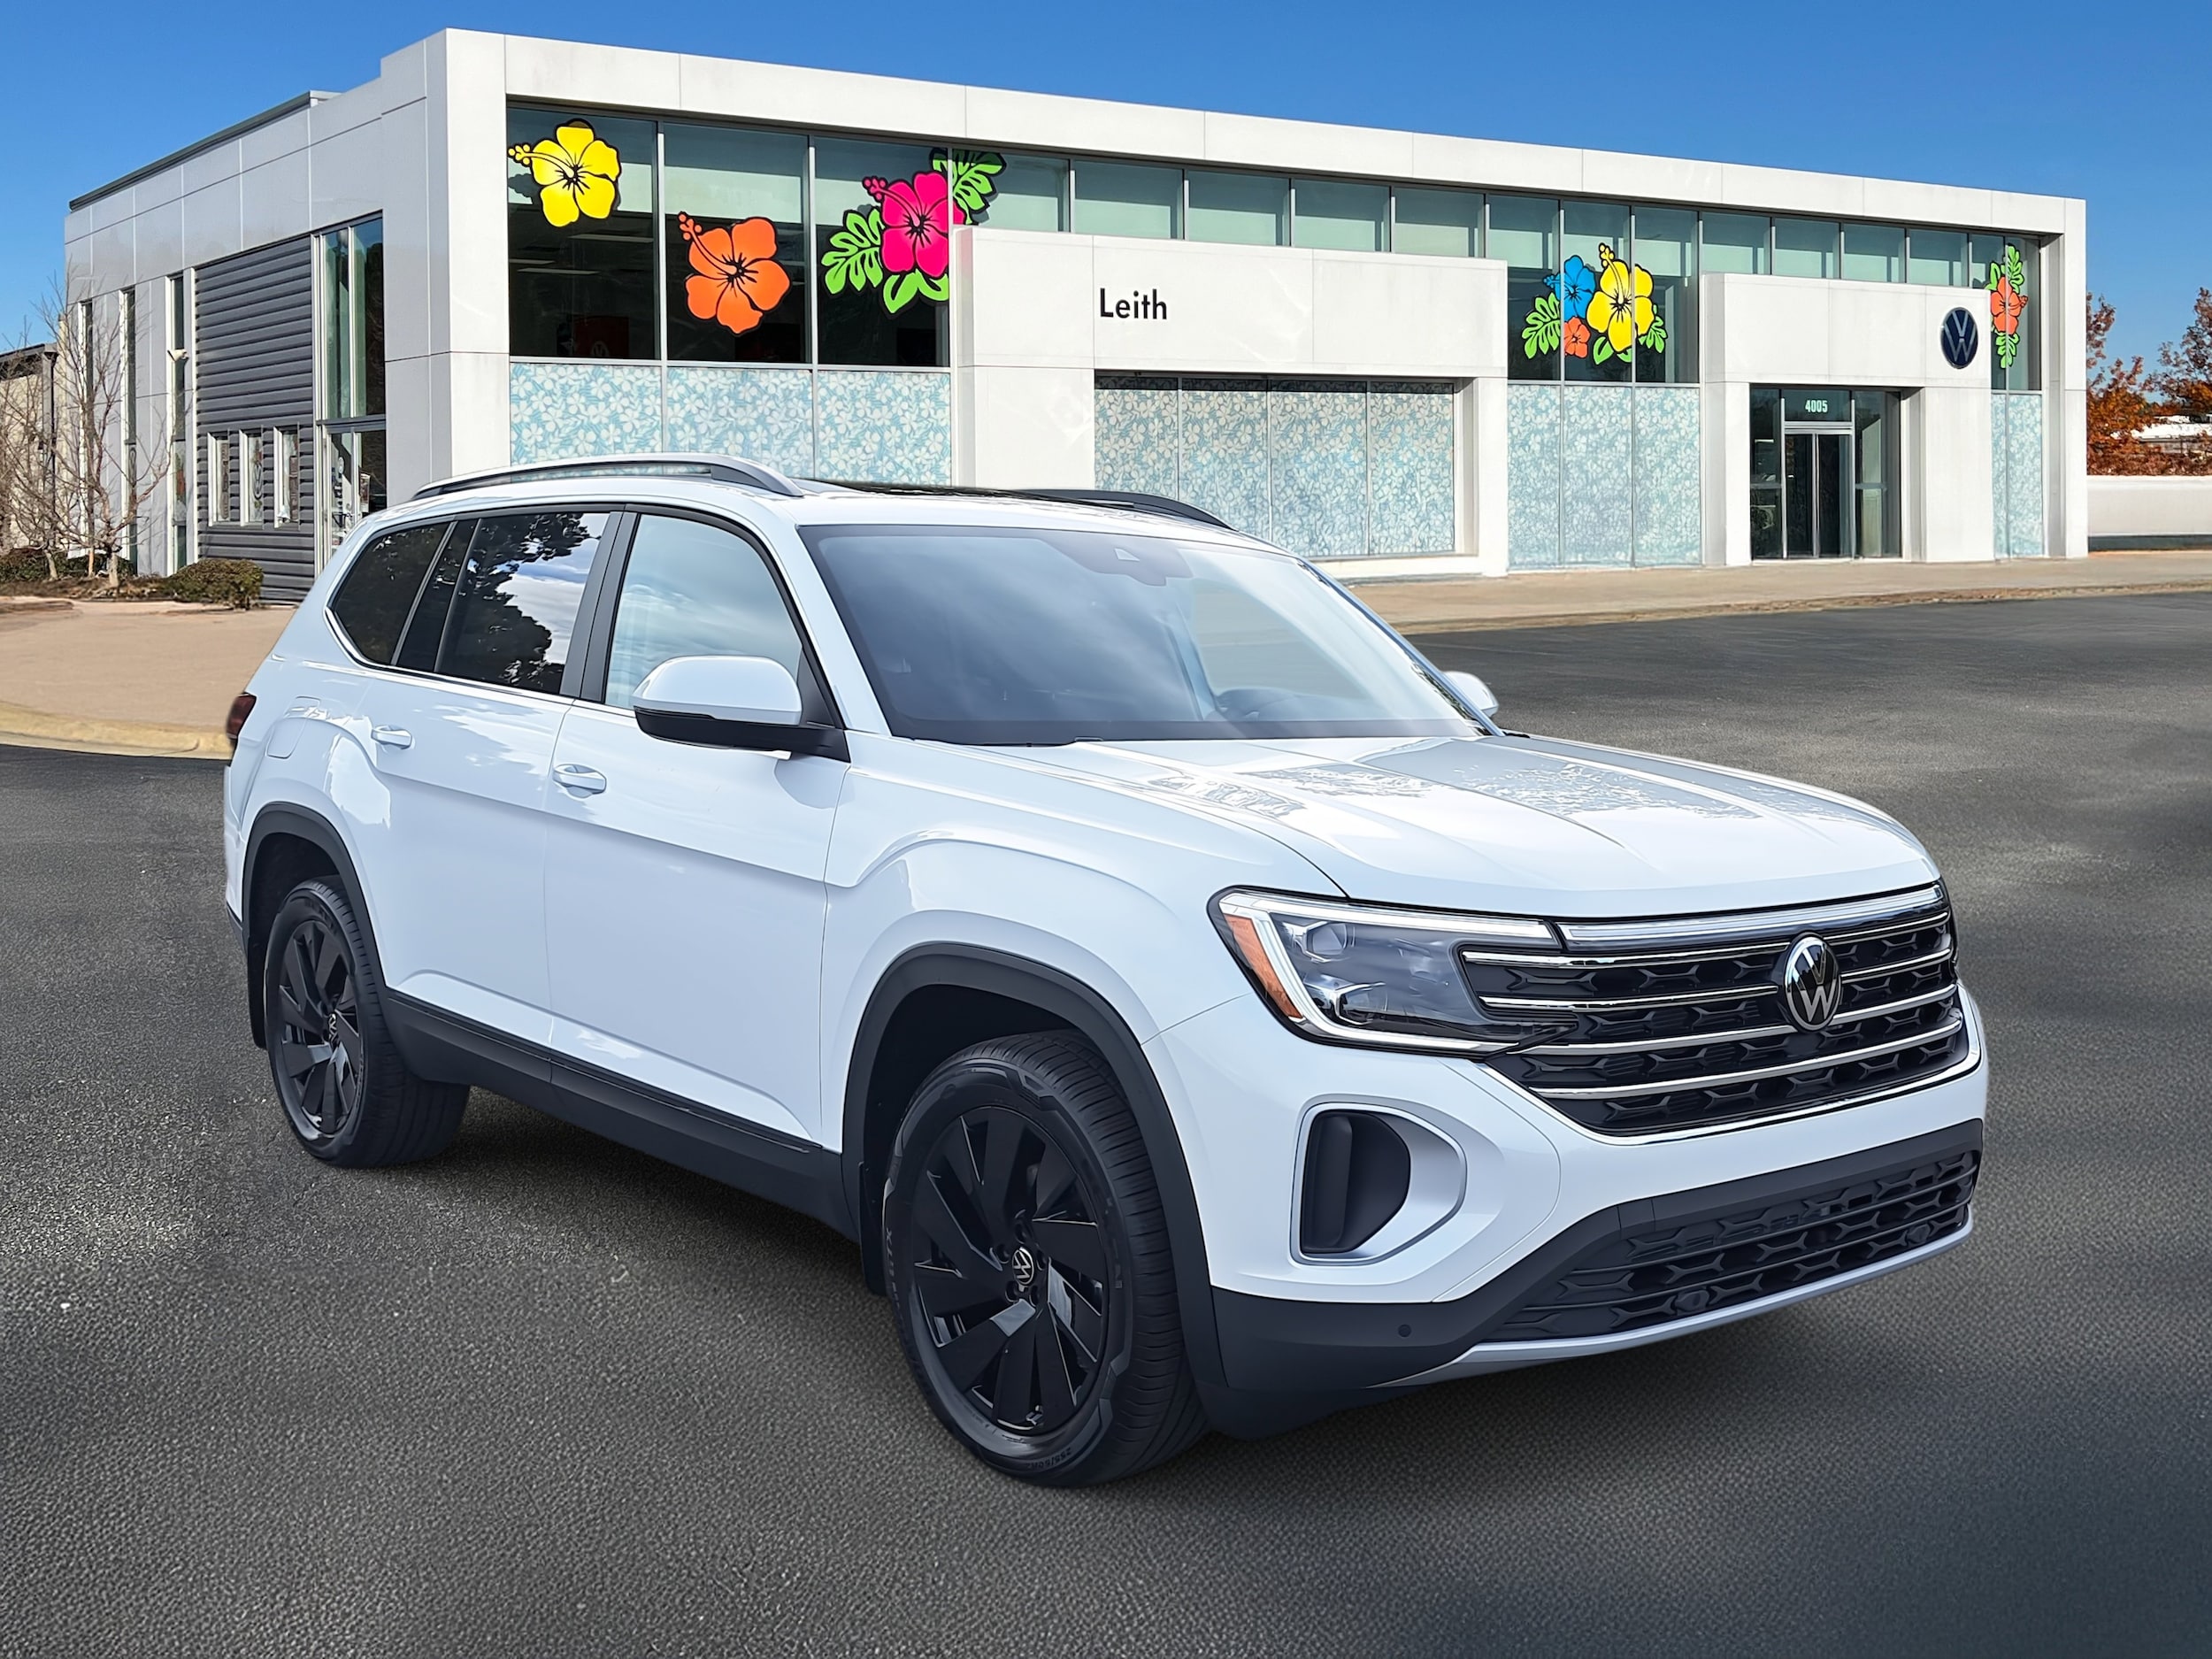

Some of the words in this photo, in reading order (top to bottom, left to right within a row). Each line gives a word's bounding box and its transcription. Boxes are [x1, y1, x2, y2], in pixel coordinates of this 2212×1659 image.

[1100, 288, 1167, 320] Leith
[1942, 309, 1978, 365] VW
[1805, 399, 1828, 413] 4005
[1788, 940, 1839, 1026] VW
